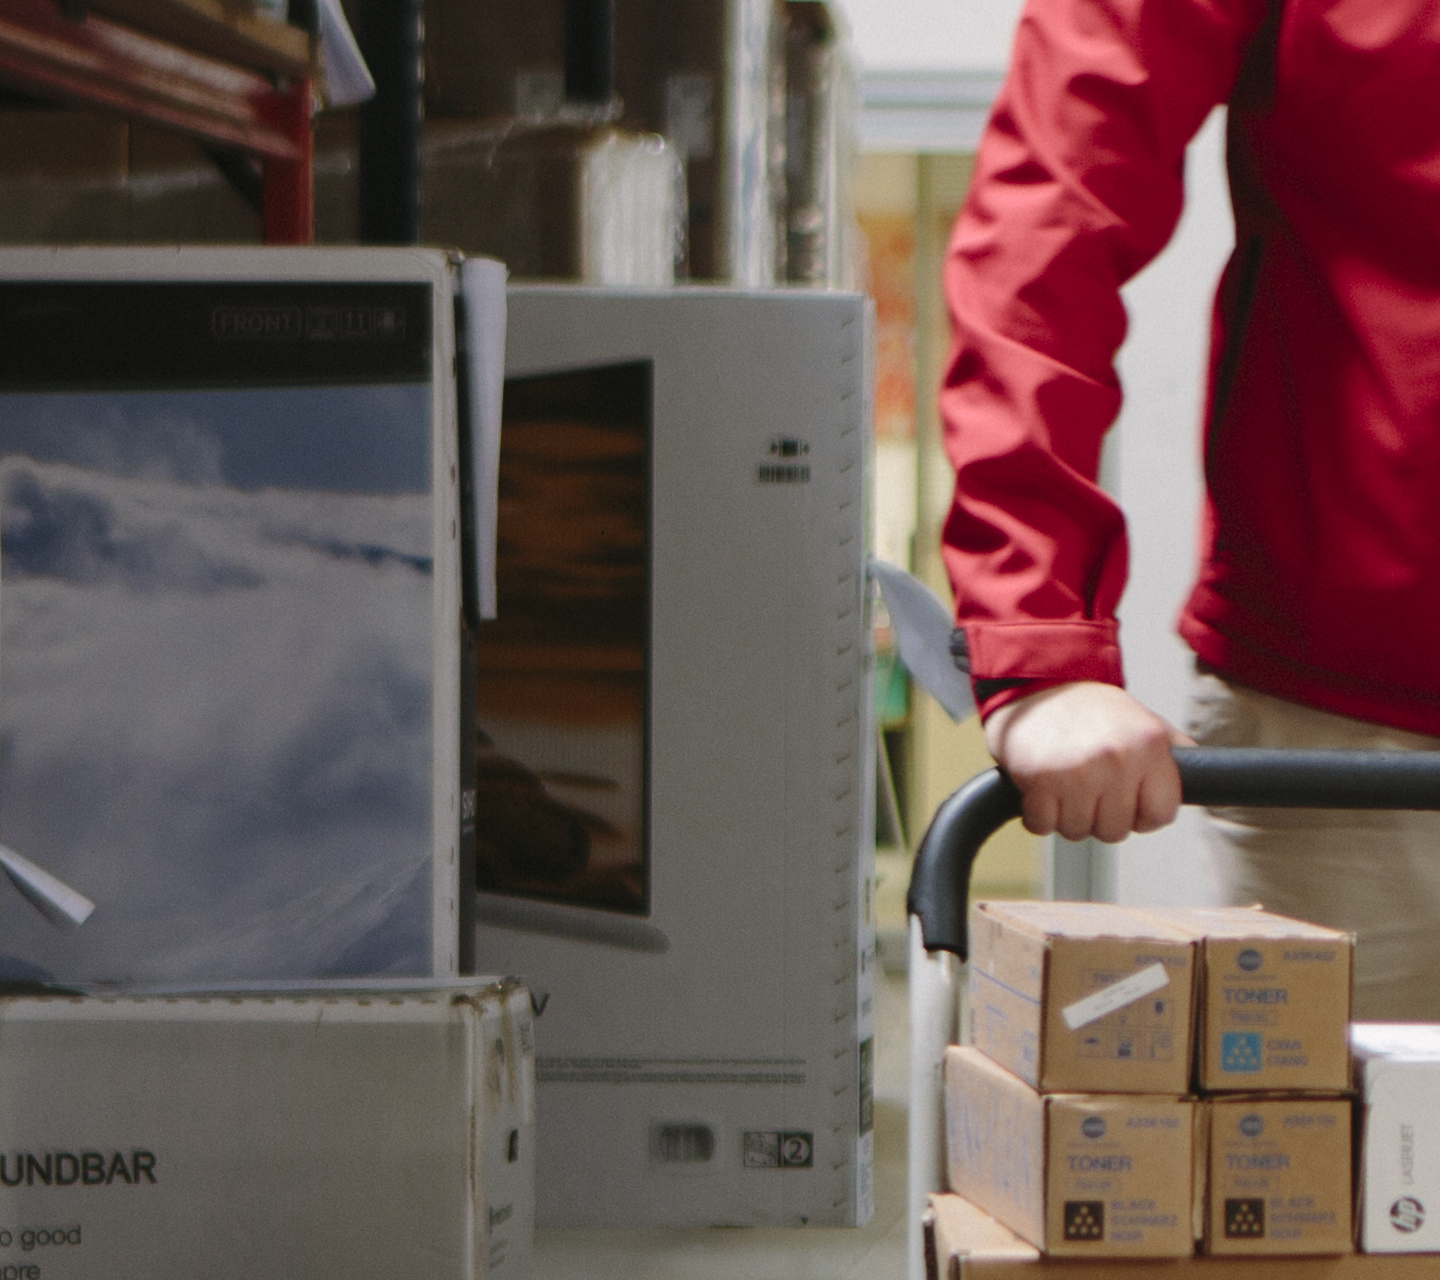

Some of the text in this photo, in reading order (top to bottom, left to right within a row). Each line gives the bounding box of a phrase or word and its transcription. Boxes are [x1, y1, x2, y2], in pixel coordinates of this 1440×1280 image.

[220, 313, 290, 334] FRONT
[1222, 987, 1288, 1005] TONER
[1067, 1154, 1132, 1172] TONER
[1225, 1154, 1290, 1171] TONER
[20, 1225, 82, 1252] good
